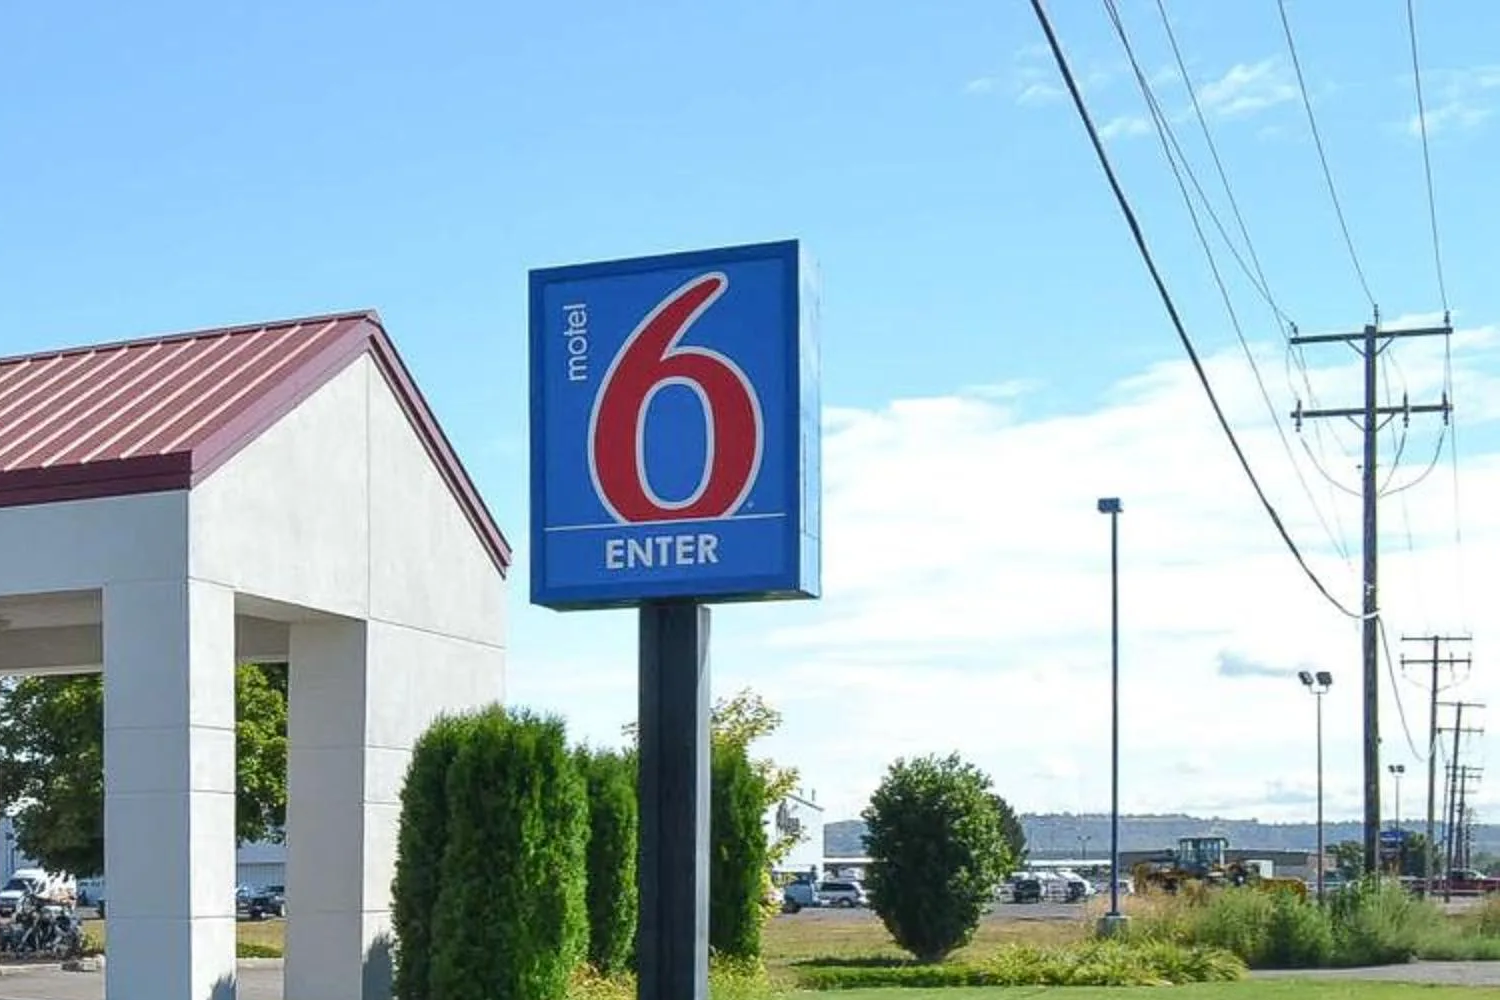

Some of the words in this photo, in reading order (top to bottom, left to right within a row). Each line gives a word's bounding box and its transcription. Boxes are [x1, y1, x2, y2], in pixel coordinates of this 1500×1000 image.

[563, 302, 587, 382] motel
[587, 271, 764, 524] 6
[605, 533, 719, 570] ENTER
